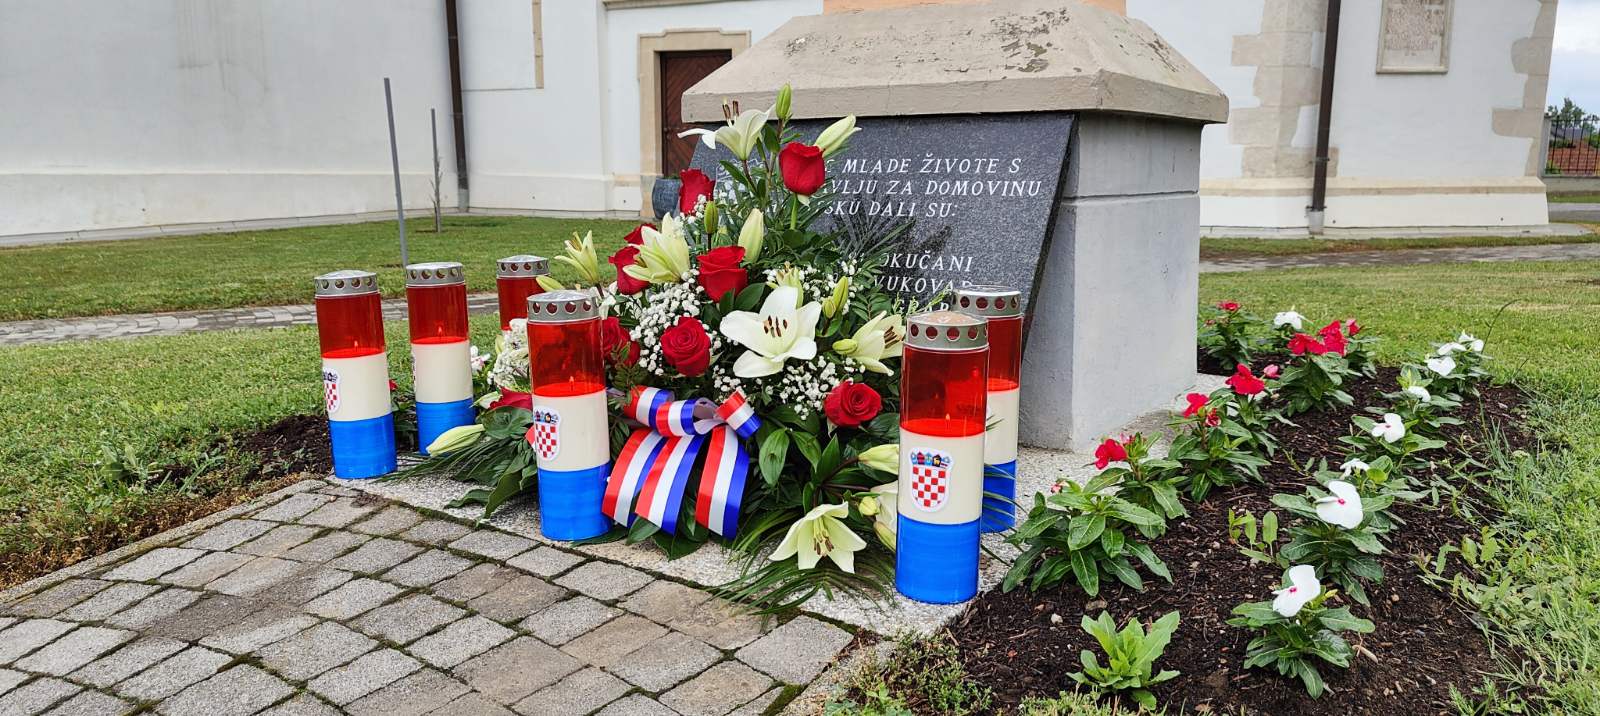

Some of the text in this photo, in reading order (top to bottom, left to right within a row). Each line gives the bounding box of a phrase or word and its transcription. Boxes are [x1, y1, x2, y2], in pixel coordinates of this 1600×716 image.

[842, 158, 911, 174] MLADE
[920, 152, 999, 174] ŽIVOTE
[1008, 158, 1021, 173] S
[886, 180, 912, 195] ZA
[925, 180, 1042, 197] DOMOVINU
[824, 200, 958, 218] SKU DALI SU:
